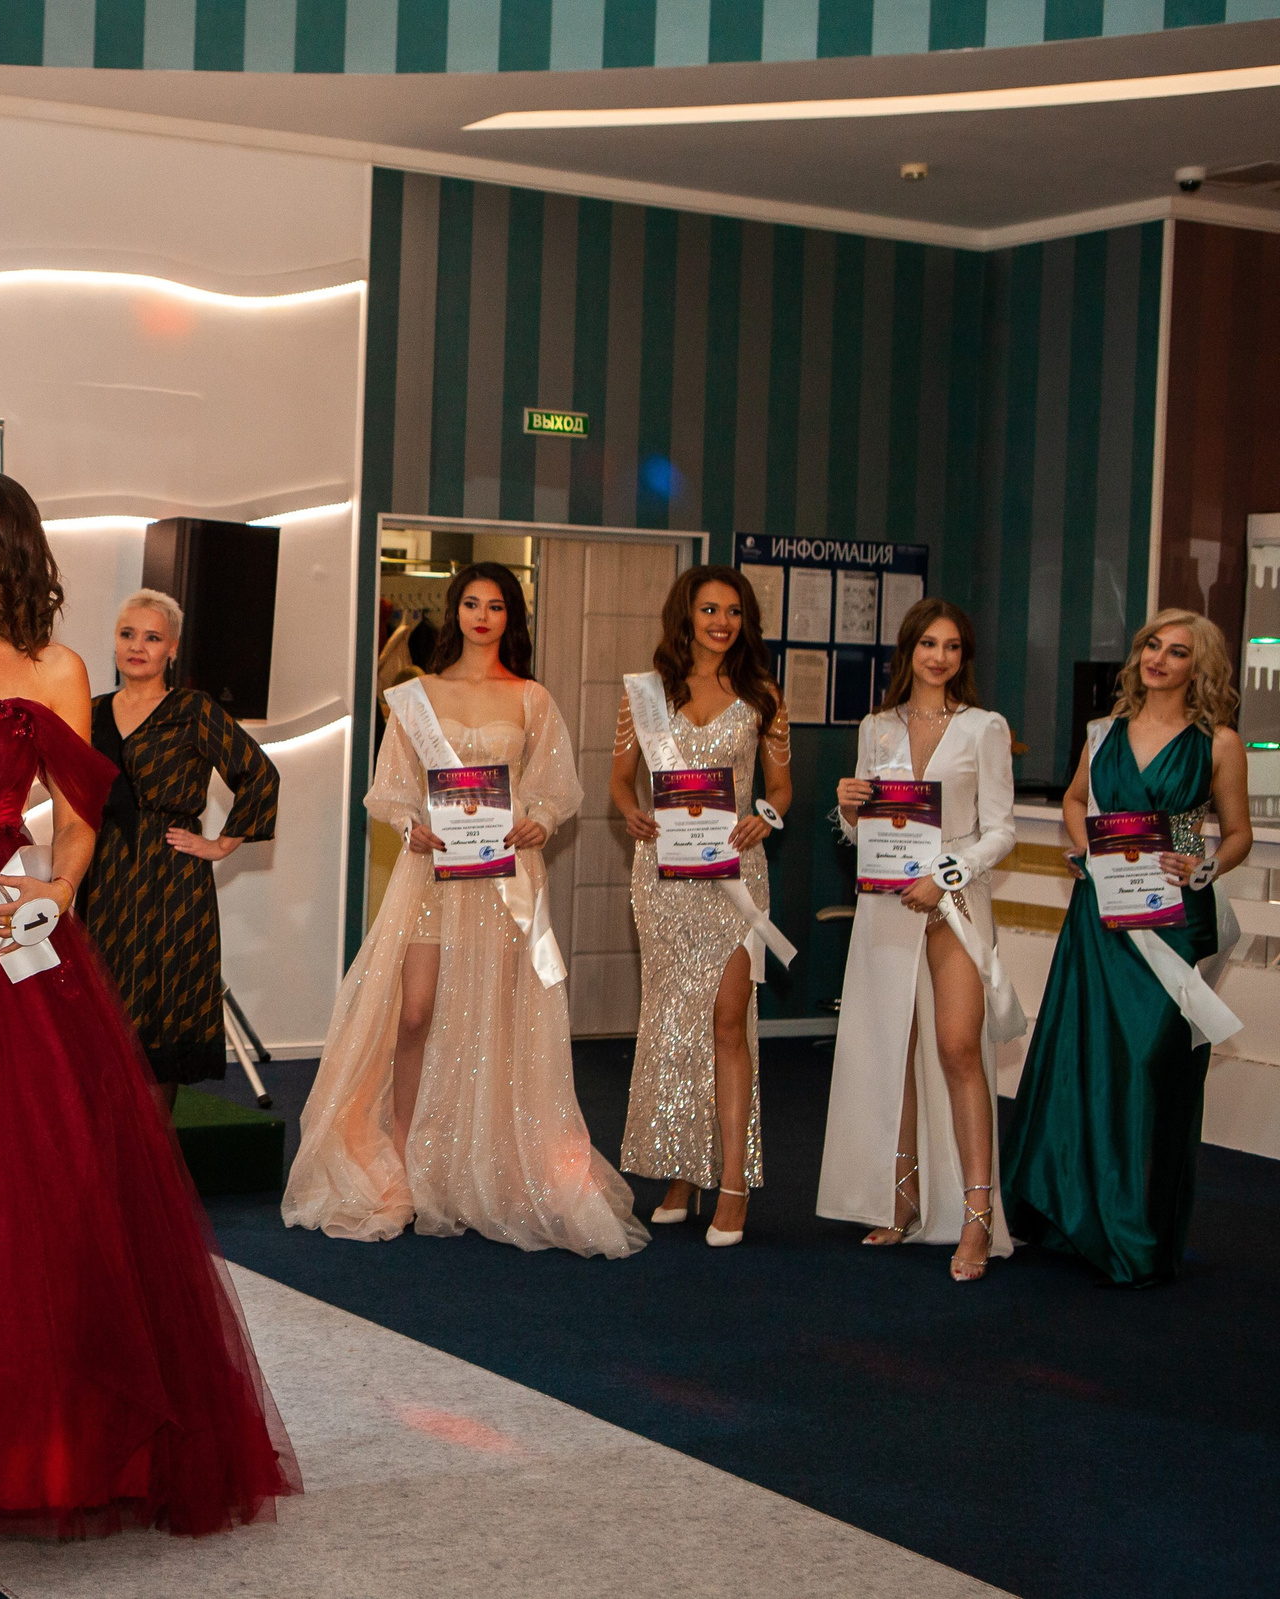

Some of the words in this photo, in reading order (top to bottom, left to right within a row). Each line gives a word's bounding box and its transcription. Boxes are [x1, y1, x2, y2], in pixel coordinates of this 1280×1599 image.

[533, 413, 584, 432] ВЫХОД
[771, 537, 894, 565] ИНФОРМАЦИЯ
[437, 768, 500, 783] CERTIFICATE
[661, 771, 724, 785] CERTIFICATE
[1094, 813, 1160, 830] CERTIFICATE
[938, 855, 963, 885] 10
[1193, 860, 1215, 884] 11
[23, 912, 49, 932] 1
